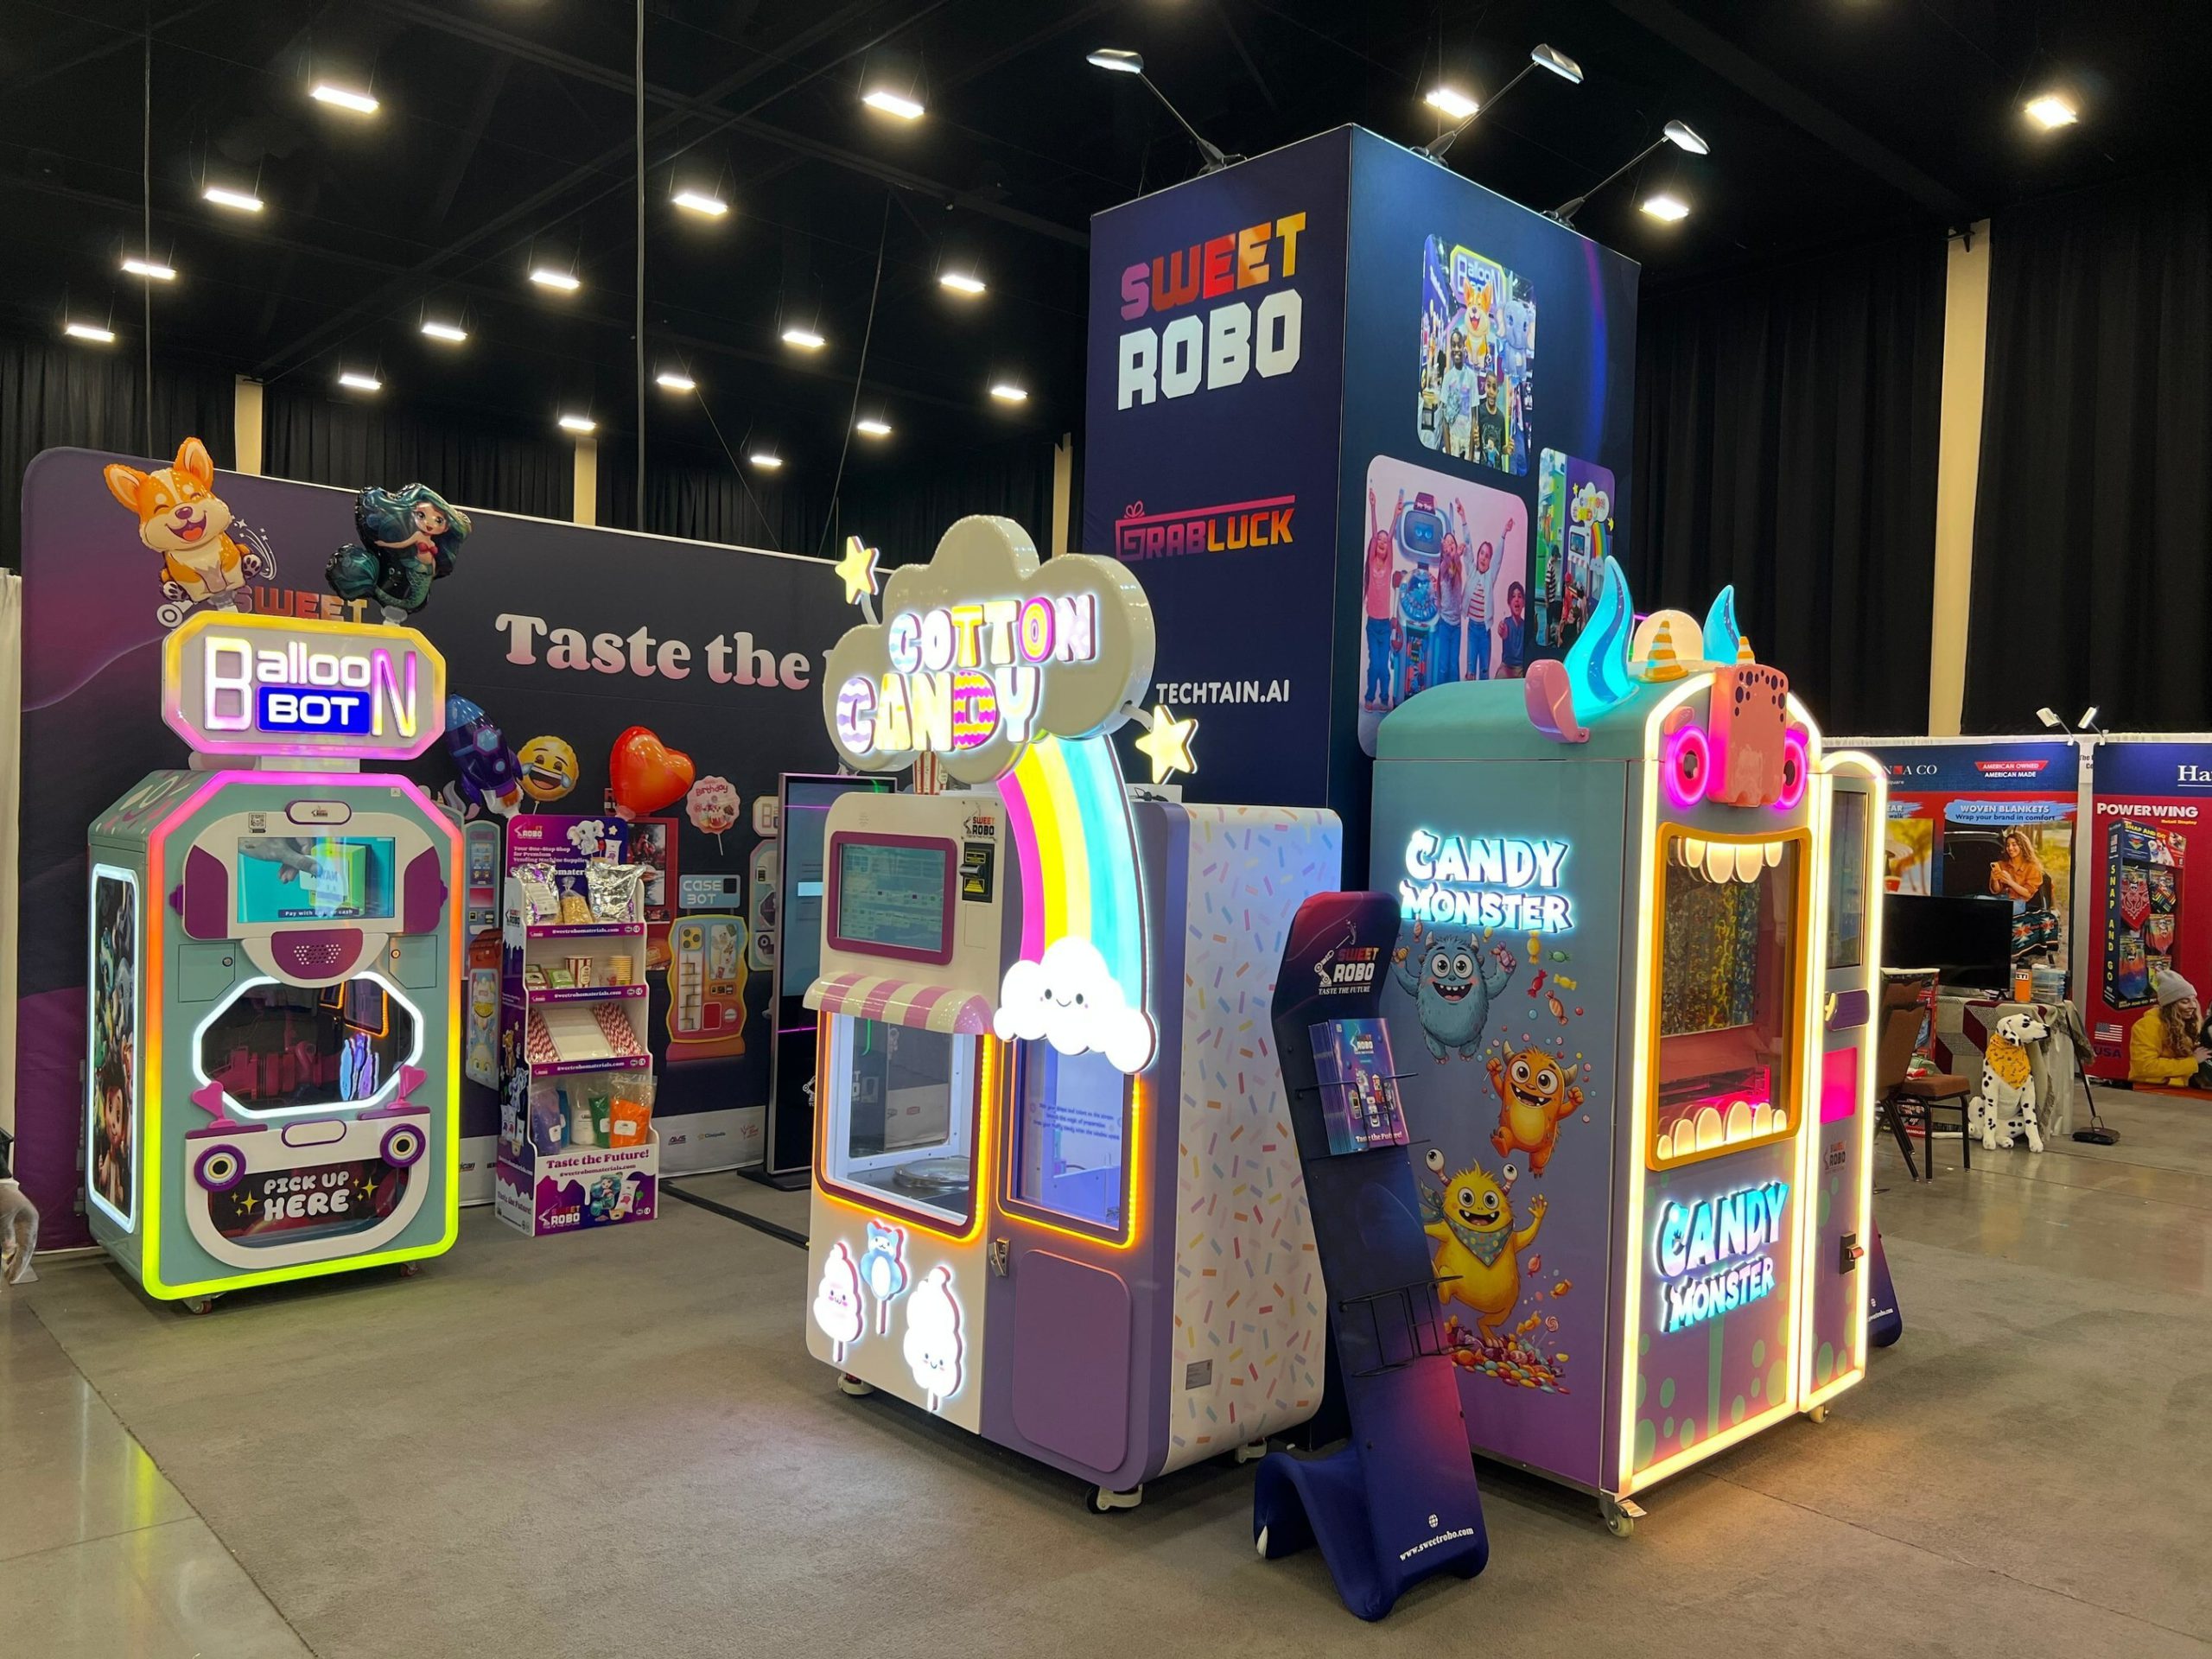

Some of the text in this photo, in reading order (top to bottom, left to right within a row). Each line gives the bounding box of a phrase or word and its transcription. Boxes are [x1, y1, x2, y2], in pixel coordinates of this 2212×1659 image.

[1121, 212, 1306, 321] SWEET
[1118, 289, 1302, 410] ROBO
[1116, 501, 1295, 562] GRABLUCK
[233, 585, 367, 624] SWEET
[889, 594, 1096, 672] COTTON
[495, 613, 691, 680] Taste
[705, 632, 810, 690] the
[1155, 679, 1290, 705] TECHTAIN.AI
[268, 694, 359, 726] BOT
[836, 666, 1040, 753] CANDY
[2177, 766, 2212, 782] Ha
[696, 785, 728, 797] Birthday
[1960, 804, 2050, 813] WOVEN BLANKETS
[972, 825, 995, 836] ROBO
[1405, 830, 1569, 889] CANDY
[683, 880, 721, 892] CASE
[1399, 880, 1574, 934] MONSTER
[1338, 947, 1379, 961] SWEET
[1333, 963, 1375, 982] ROBO
[2107, 961, 2113, 982] GO
[2094, 1046, 2122, 1058] USA
[546, 1157, 580, 1169] Taste
[582, 1154, 602, 1165] the
[604, 1149, 650, 1163] Future!
[1829, 1151, 1847, 1166] ROBO
[264, 1171, 349, 1195] PICK UP
[264, 1189, 350, 1221] HERE
[551, 1213, 581, 1224] ROBO
[1654, 1180, 1790, 1277] CANDY
[1661, 1255, 1776, 1332] MONSTER
[1400, 1528, 1473, 1561] www.sweetrobo.com
